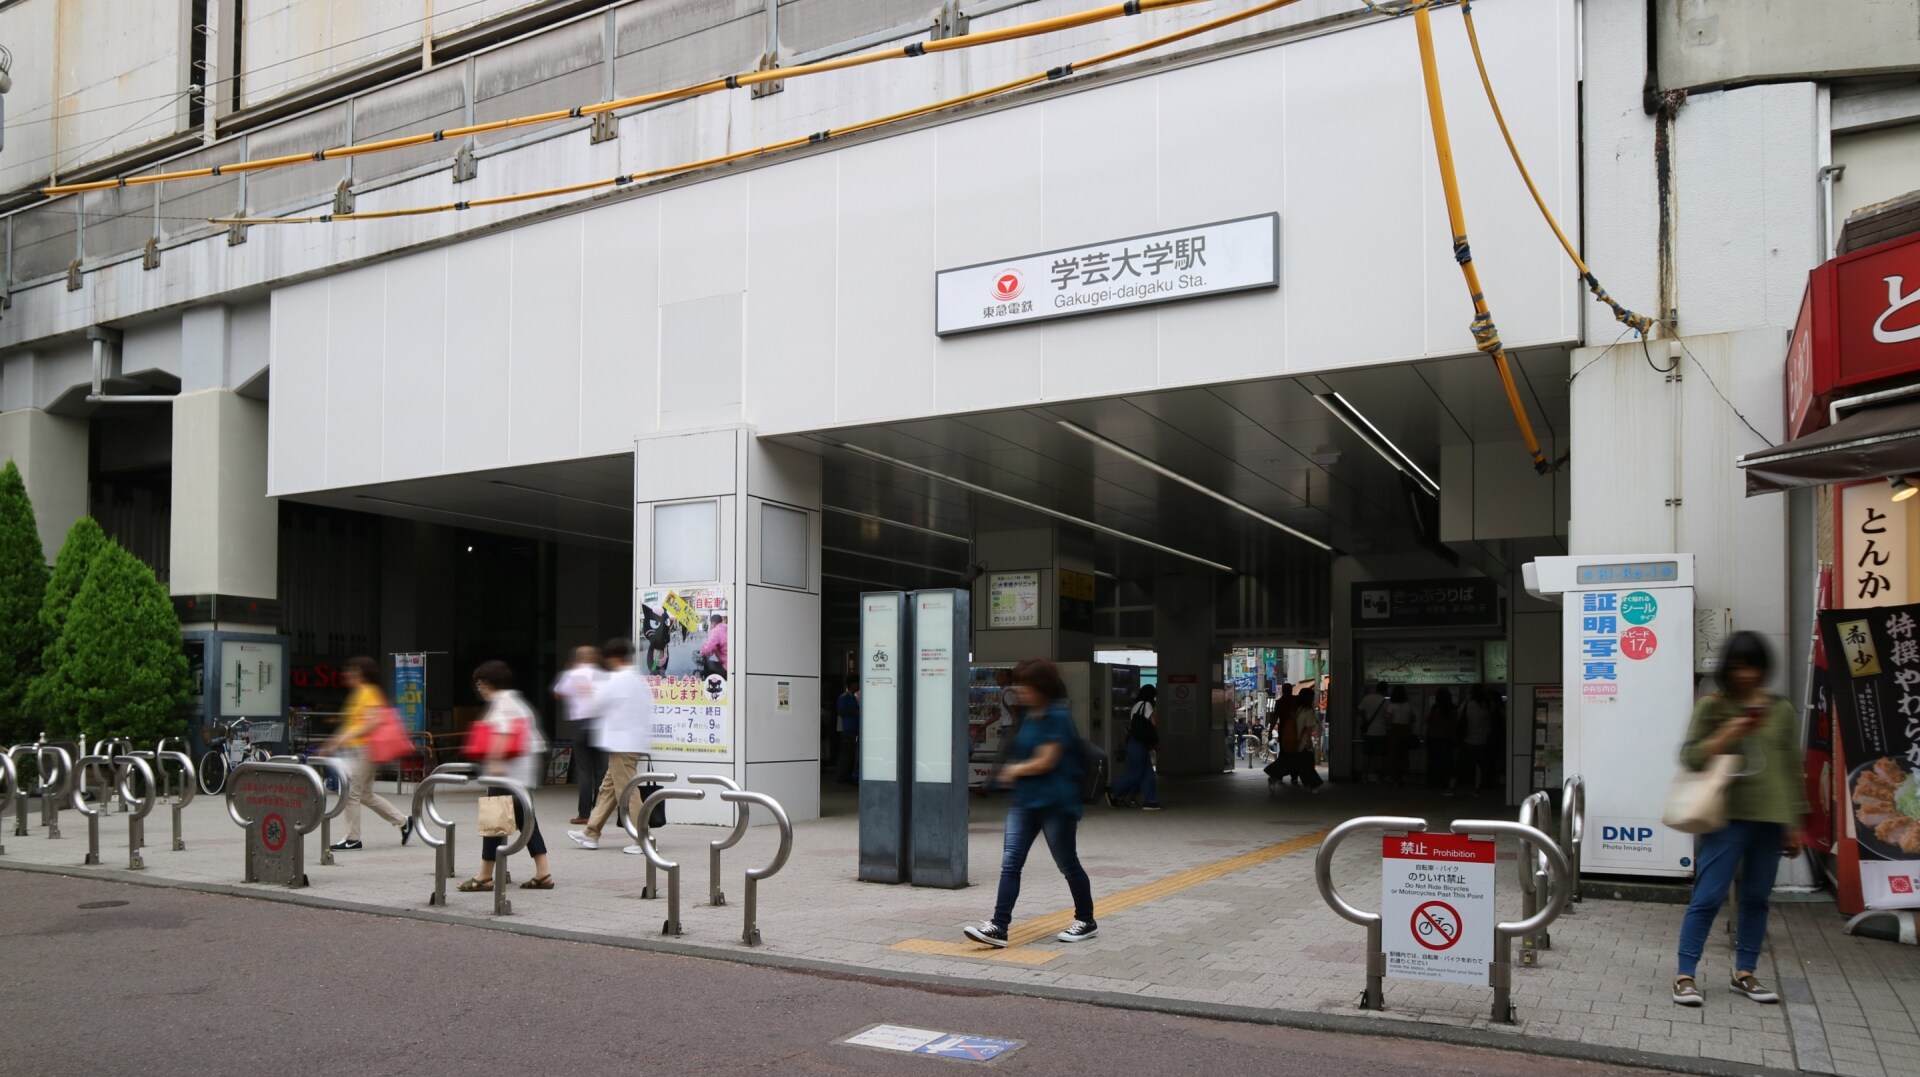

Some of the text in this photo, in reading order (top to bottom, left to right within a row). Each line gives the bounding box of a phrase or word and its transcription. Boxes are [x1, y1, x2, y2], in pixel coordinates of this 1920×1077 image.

[1050, 235, 1207, 291] 学芸大学駅
[1054, 273, 1207, 309] Gakugei-daigaku Sta.
[982, 299, 1034, 319] 東急電鉄
[697, 597, 721, 609] 自転車
[1622, 603, 1656, 614] シール
[1583, 593, 1617, 680] 証明写真
[1621, 630, 1650, 638] スピード
[1629, 639, 1647, 652] 17
[1845, 625, 1874, 672] 希少
[1583, 685, 1617, 693] PASMO
[1602, 826, 1653, 842] DNP
[1400, 841, 1476, 859] 禁止 Prohibition
[1602, 843, 1652, 853] Photo Imaging
[1408, 872, 1466, 884] のりいれ禁止
[1399, 889, 1436, 897] Motorcycles
